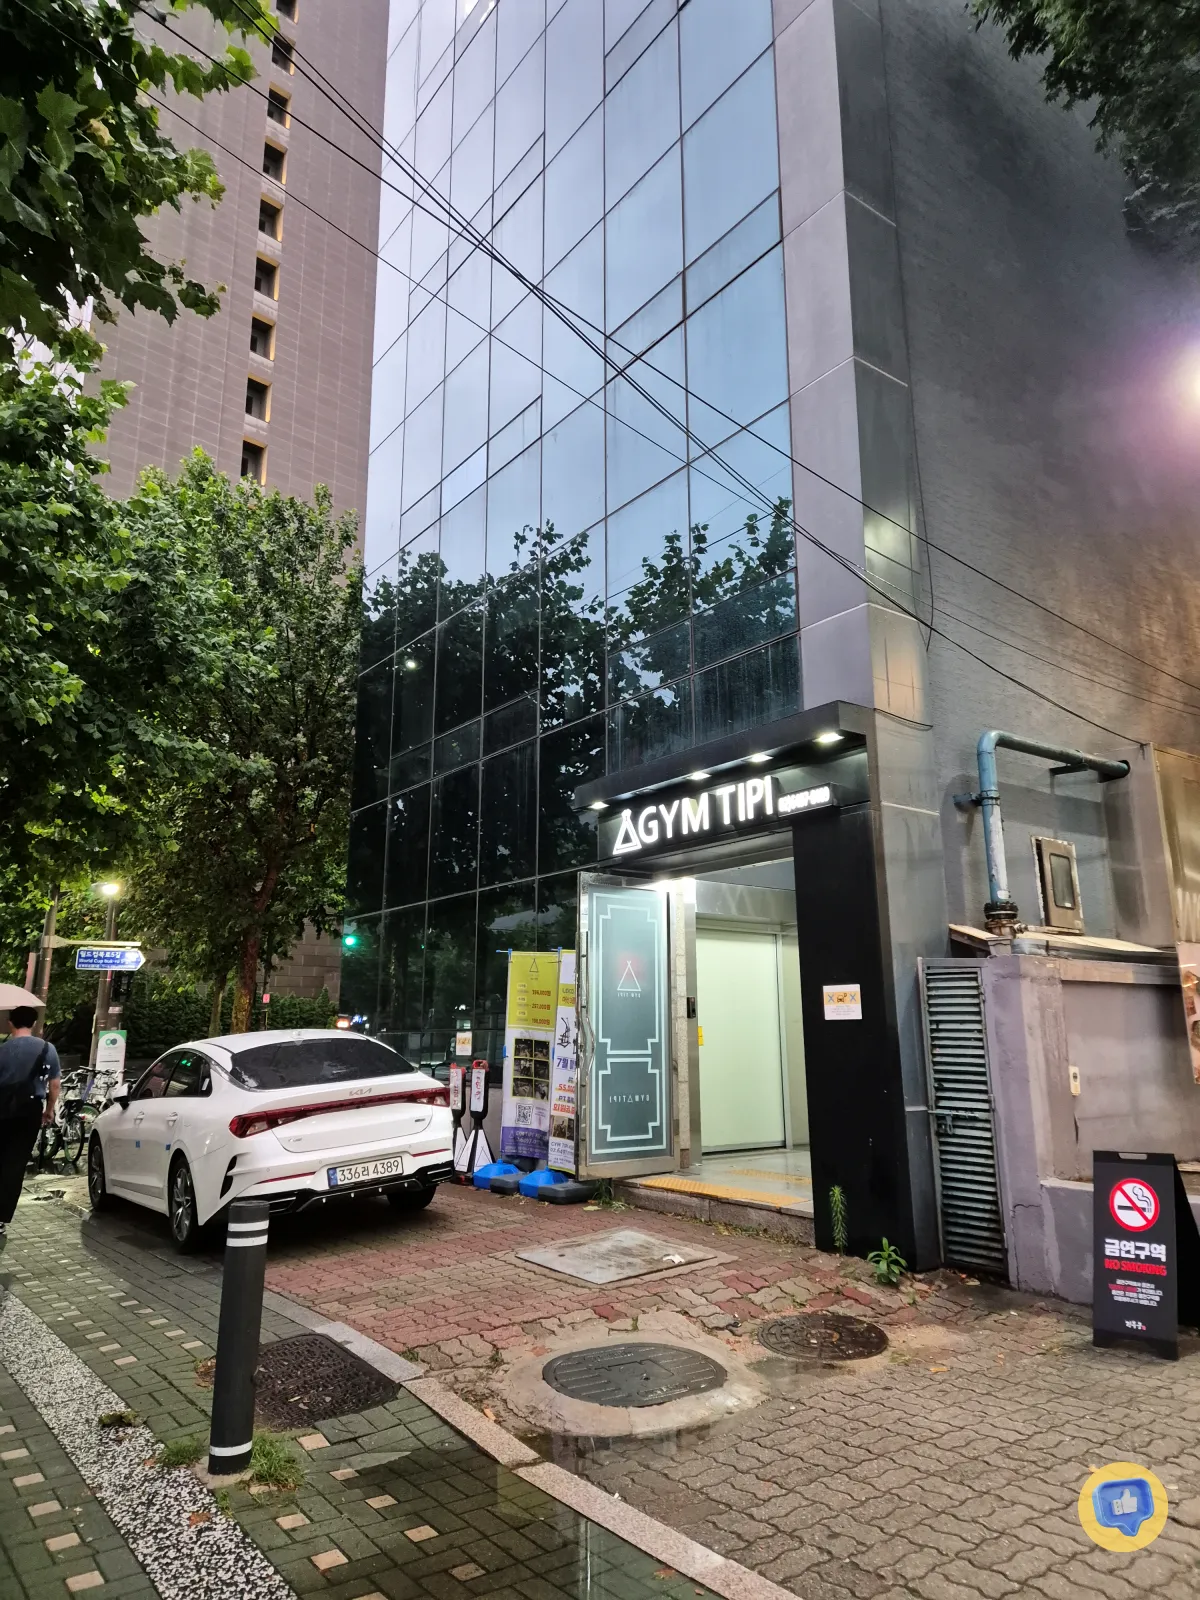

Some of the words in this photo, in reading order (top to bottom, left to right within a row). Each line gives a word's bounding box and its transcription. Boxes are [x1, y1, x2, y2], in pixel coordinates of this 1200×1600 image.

[638, 792, 709, 844] GYM
[717, 775, 774, 825] TIPI
[349, 1087, 372, 1096] KIA
[372, 1160, 400, 1176] 4389
[1104, 1238, 1167, 1262] 금연구역
[1104, 1258, 1120, 1270] NO
[1121, 1261, 1167, 1276] SMOKING
